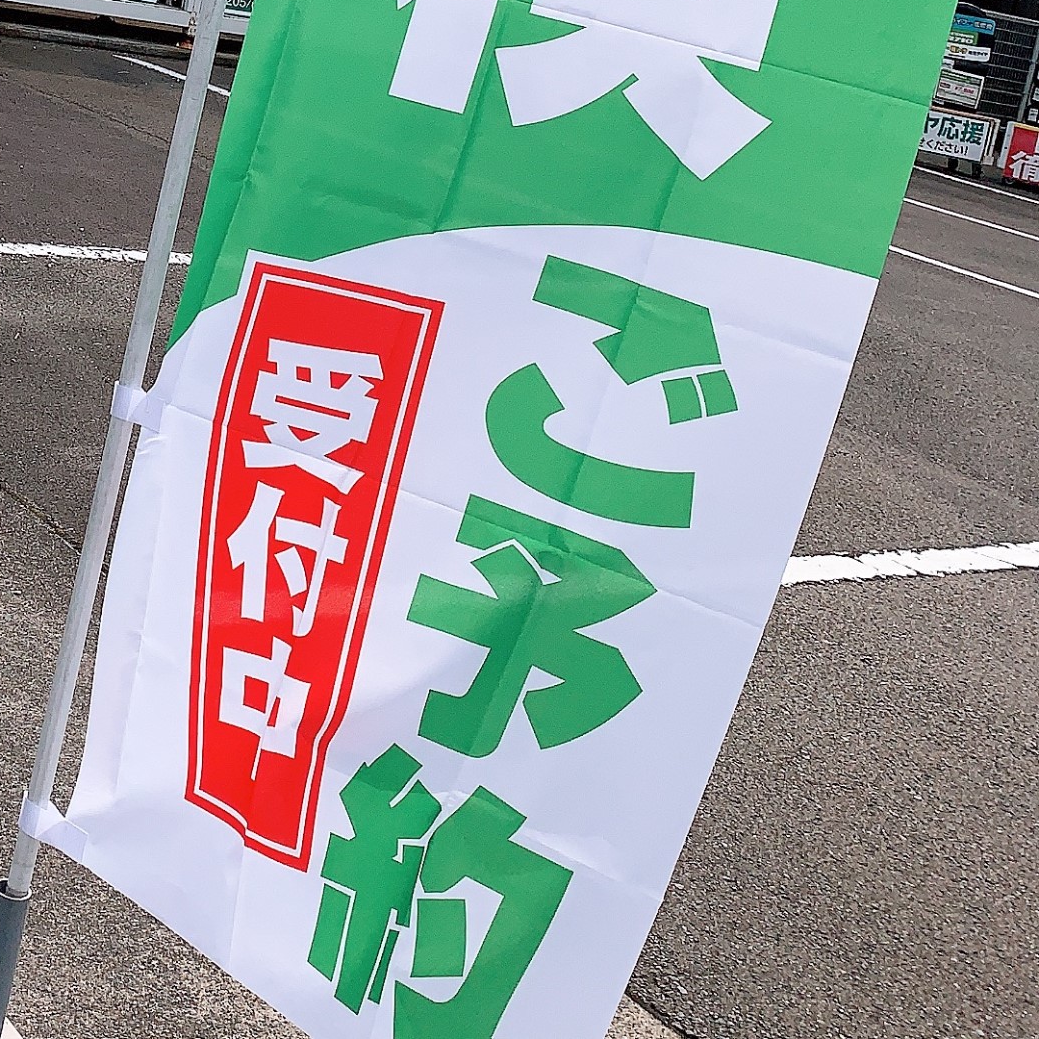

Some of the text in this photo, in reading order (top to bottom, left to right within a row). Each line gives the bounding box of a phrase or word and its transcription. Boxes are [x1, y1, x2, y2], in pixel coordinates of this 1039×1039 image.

[217, 338, 384, 781] 受付中
[307, 255, 739, 1039] ご予約
